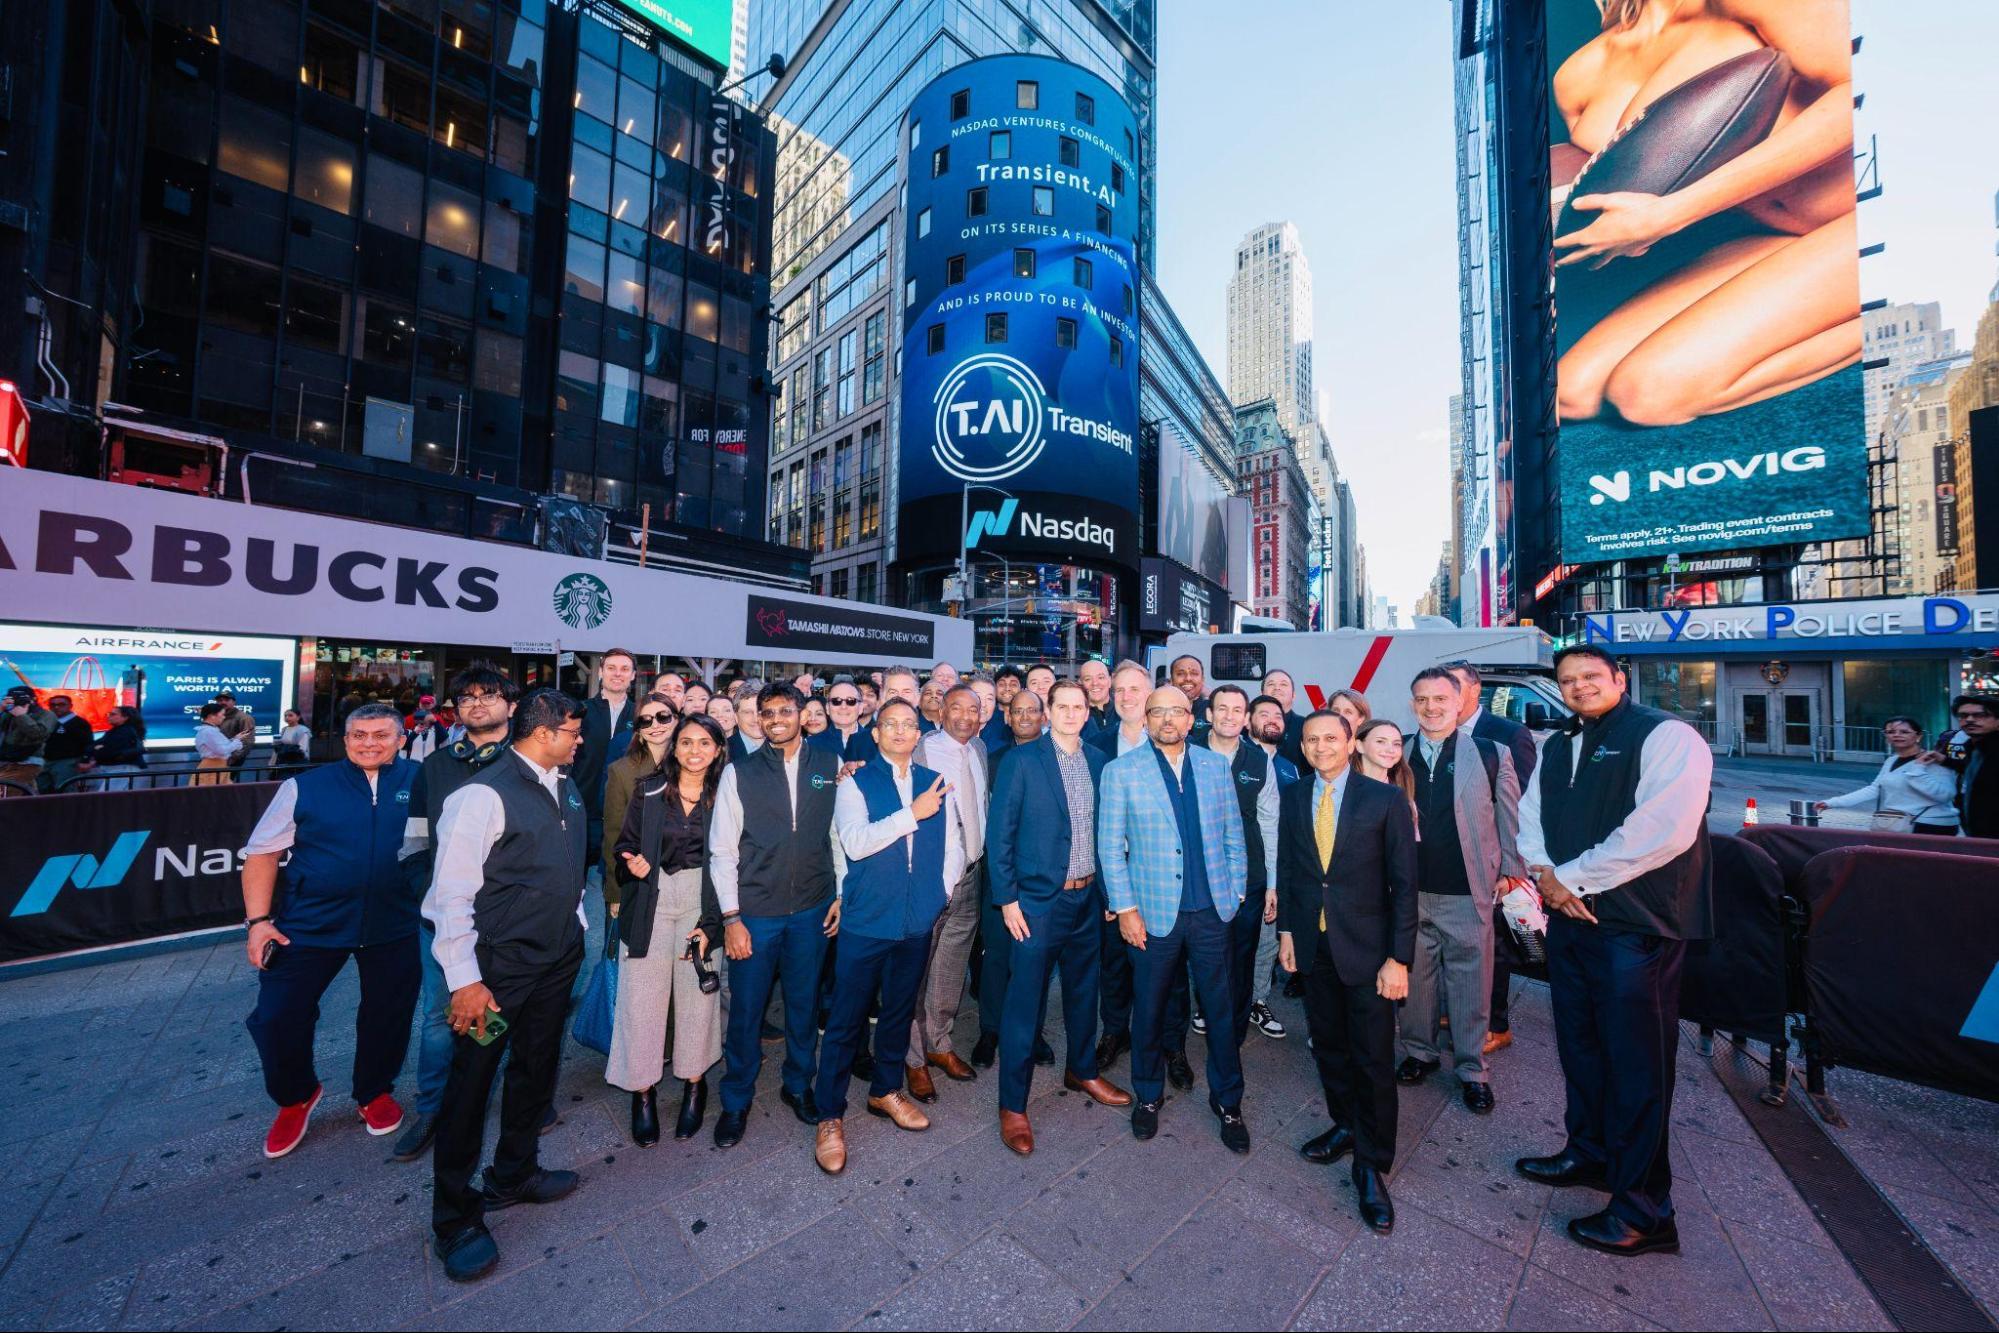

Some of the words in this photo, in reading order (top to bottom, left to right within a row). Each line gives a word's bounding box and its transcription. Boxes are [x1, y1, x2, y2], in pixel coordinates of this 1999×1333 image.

[951, 117, 998, 138] NASDAQ
[1003, 116, 1066, 132] VENTURES
[1070, 126, 1136, 181] CONGRATULATES
[976, 163, 1116, 208] Transient.AI
[961, 225, 979, 239] ON
[985, 223, 1006, 235] ITS
[1011, 223, 1057, 237] SERIES
[1062, 228, 1070, 239] A
[1075, 232, 1128, 270] FINANCING
[937, 297, 963, 313] AND
[968, 294, 980, 305] IS
[986, 291, 1033, 302] PROUD
[1039, 293, 1056, 305] TO
[1062, 297, 1077, 309] BE
[1082, 302, 1097, 316] AN
[1100, 309, 1136, 342] INVESTOR
[1048, 407, 1133, 455] Transient
[1649, 446, 1826, 492] NOVIG
[1020, 511, 1115, 553] Nasdaq
[1585, 534, 1618, 544] Terms
[1620, 529, 1653, 540] apply.
[1677, 521, 1724, 533] Trading
[1726, 516, 1763, 528] event
[1765, 509, 1834, 524] contracts
[1600, 540, 1644, 551] involves
[1672, 534, 1696, 544] See
[1698, 522, 1813, 541] novig.com/terms
[0, 509, 500, 613] RBUCKS
[892, 631, 909, 642] NEW
[910, 633, 929, 644] YORK
[166, 675, 204, 684] PARIS
[207, 676, 218, 684] IS
[221, 677, 272, 685] ALWAYS
[235, 685, 265, 693] VISIT
